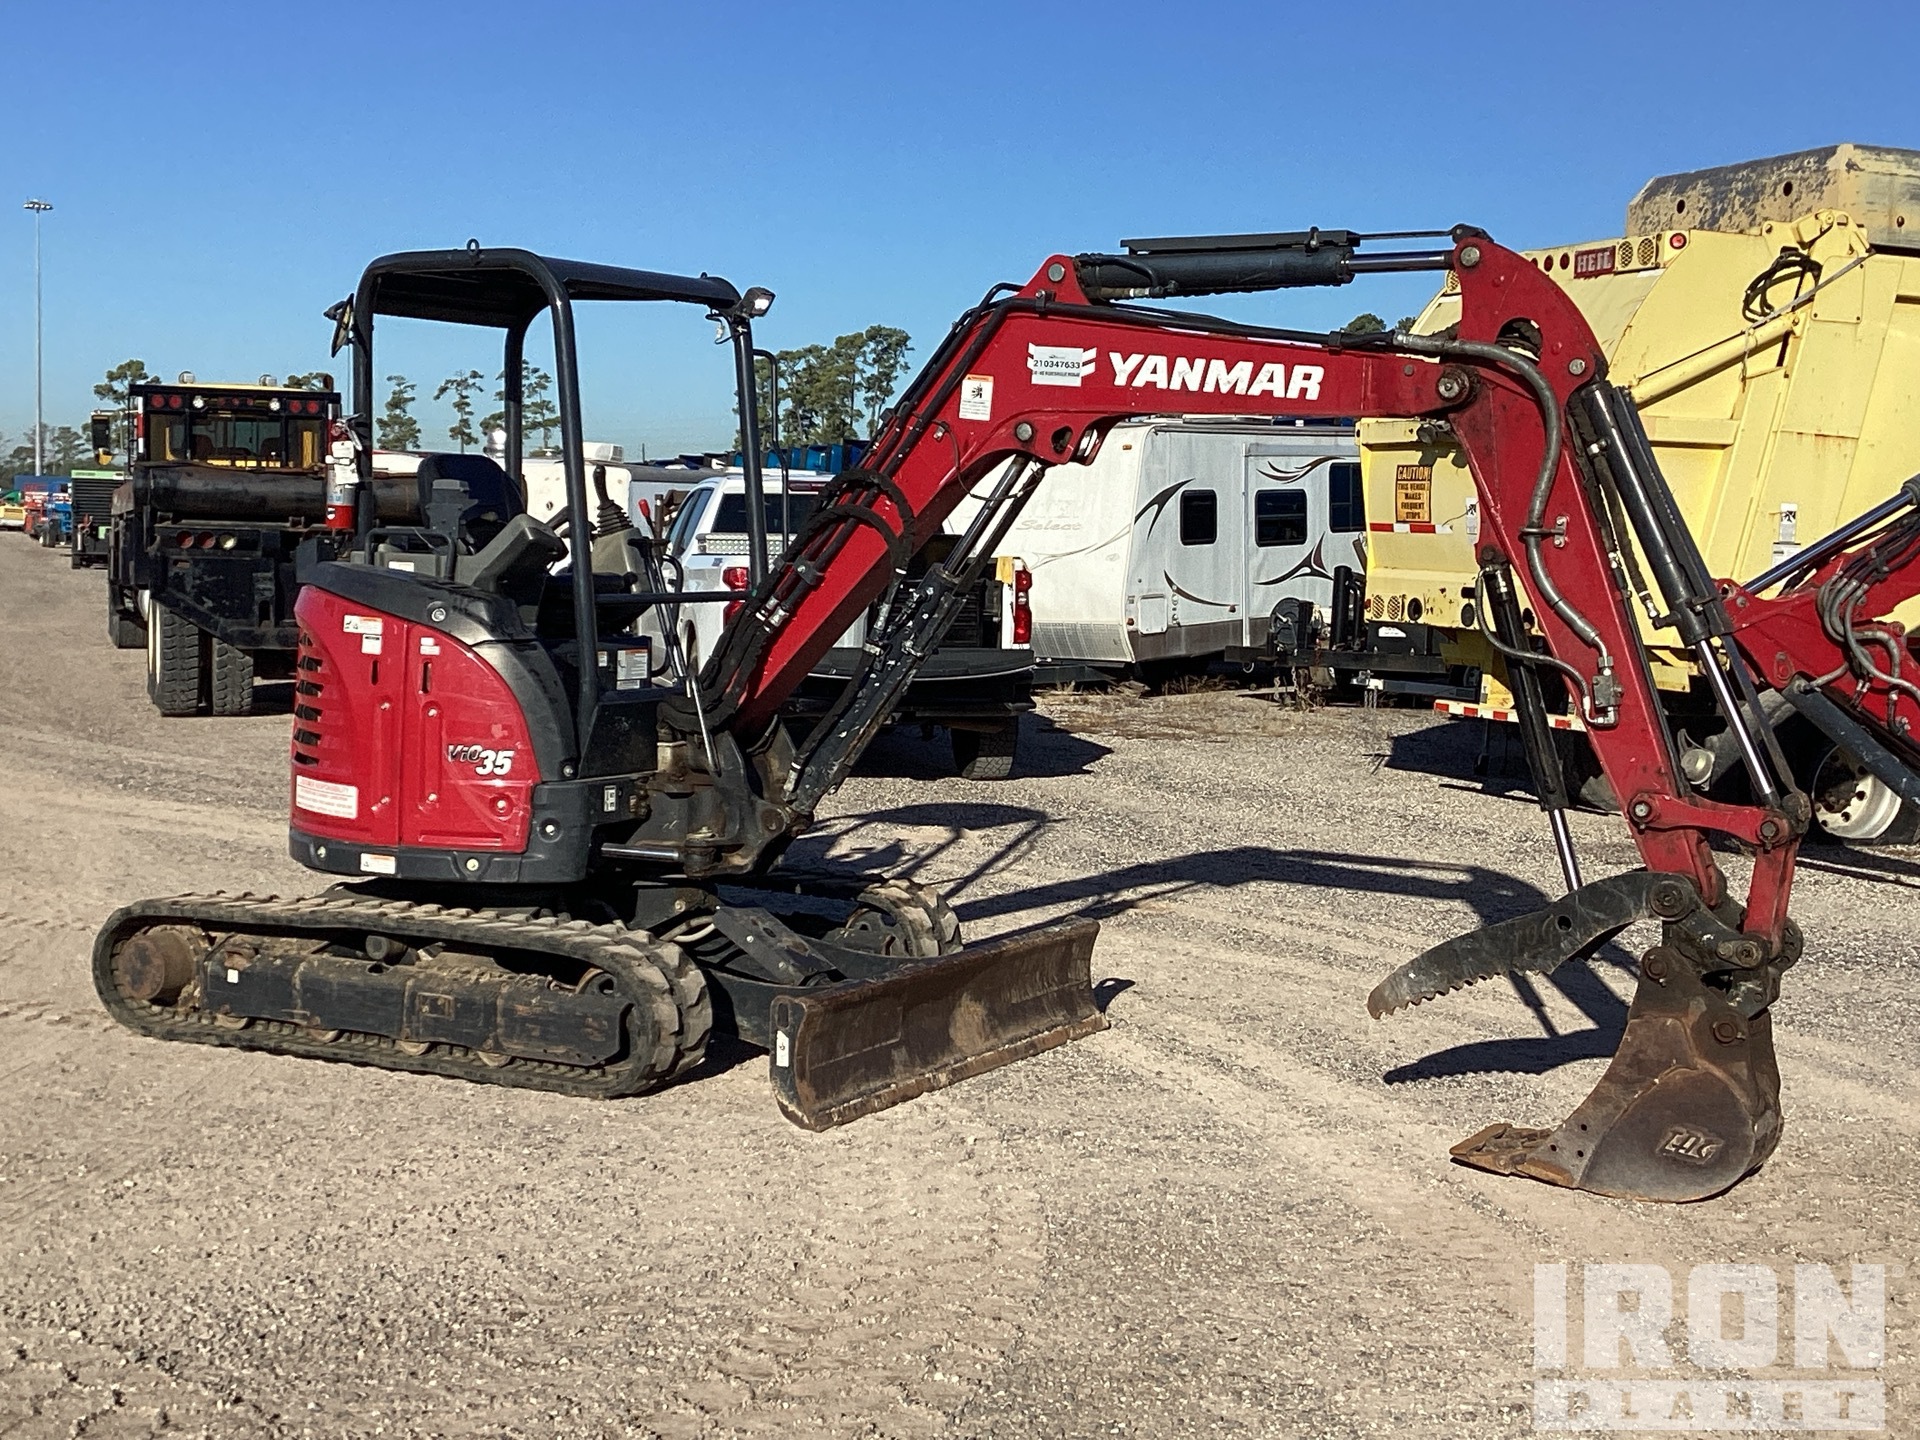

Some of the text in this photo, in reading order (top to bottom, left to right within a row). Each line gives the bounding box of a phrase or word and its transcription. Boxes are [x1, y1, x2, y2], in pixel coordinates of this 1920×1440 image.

[1577, 252, 1612, 273] HEIL
[1033, 359, 1081, 369] 210347633
[1109, 351, 1325, 401] YANMAR
[1397, 483, 1409, 491] THIS
[1404, 492, 1421, 500] MAKES
[1401, 502, 1425, 510] FREQUENT
[1016, 519, 1081, 531] Select
